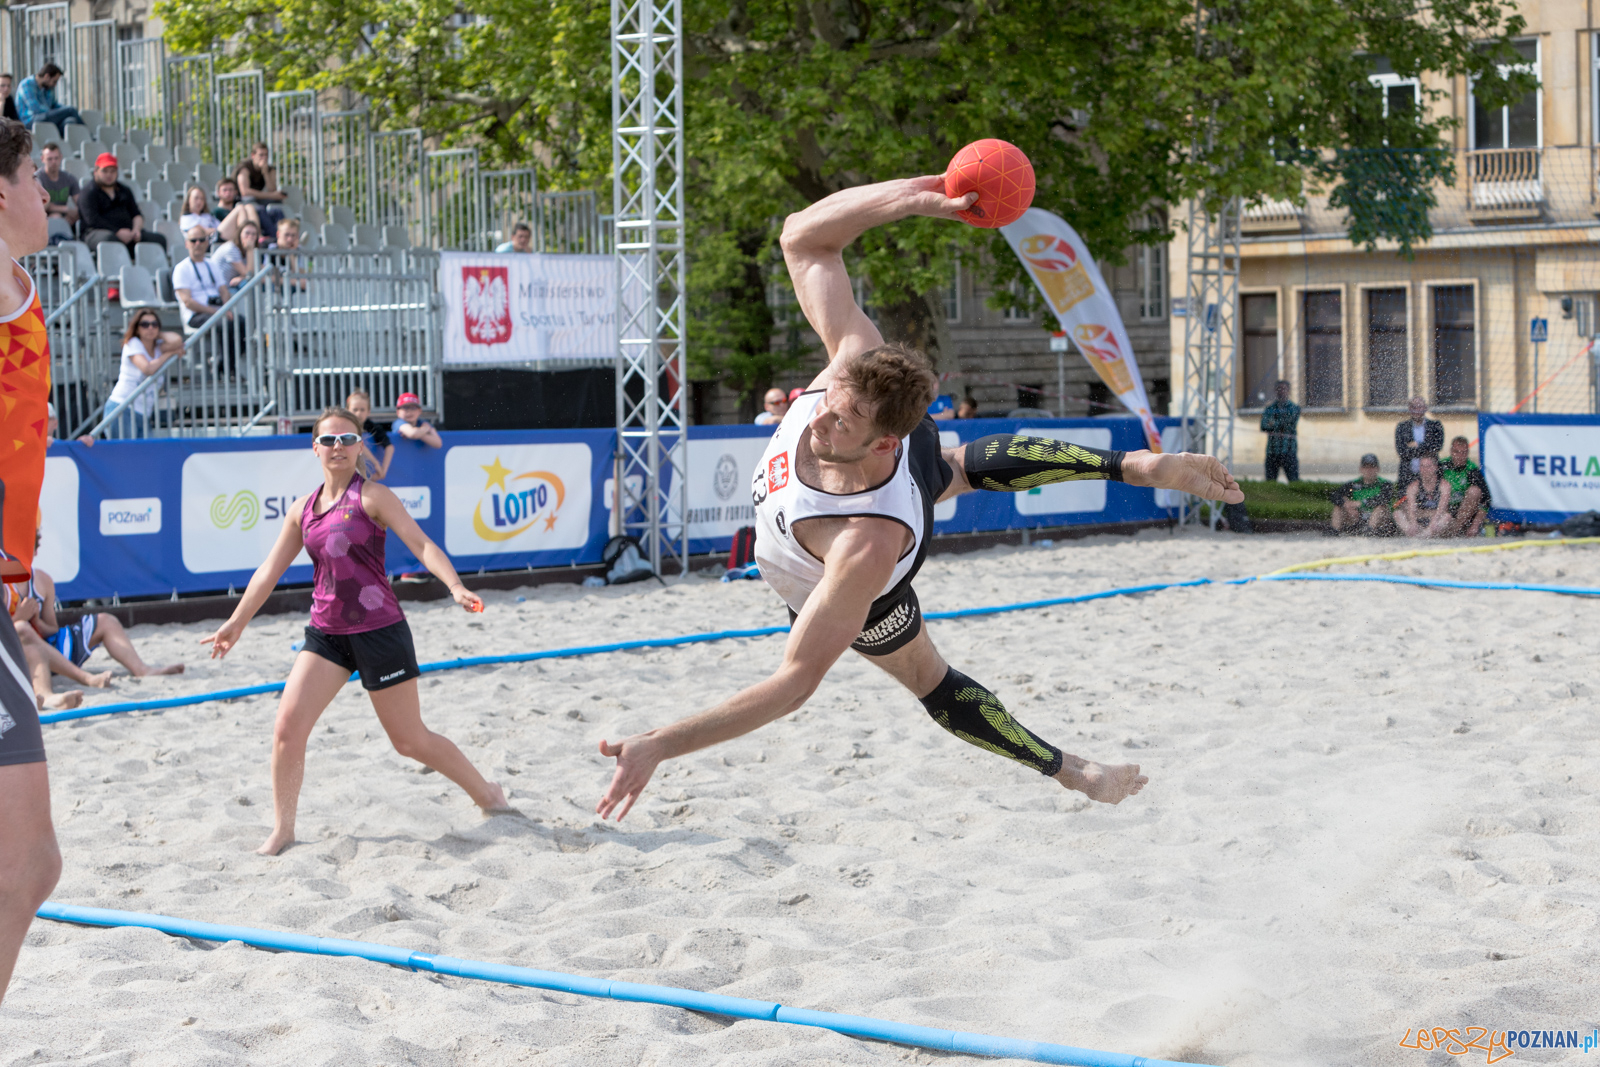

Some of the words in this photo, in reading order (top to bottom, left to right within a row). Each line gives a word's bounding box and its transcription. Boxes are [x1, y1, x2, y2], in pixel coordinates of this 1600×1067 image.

[519, 282, 605, 298] Ministerstwo
[520, 311, 565, 328] Sportu
[1514, 454, 1600, 476] TERLA
[1550, 480, 1578, 489] GRUPA
[492, 483, 547, 527] LOTTO
[862, 614, 907, 642] mafia
